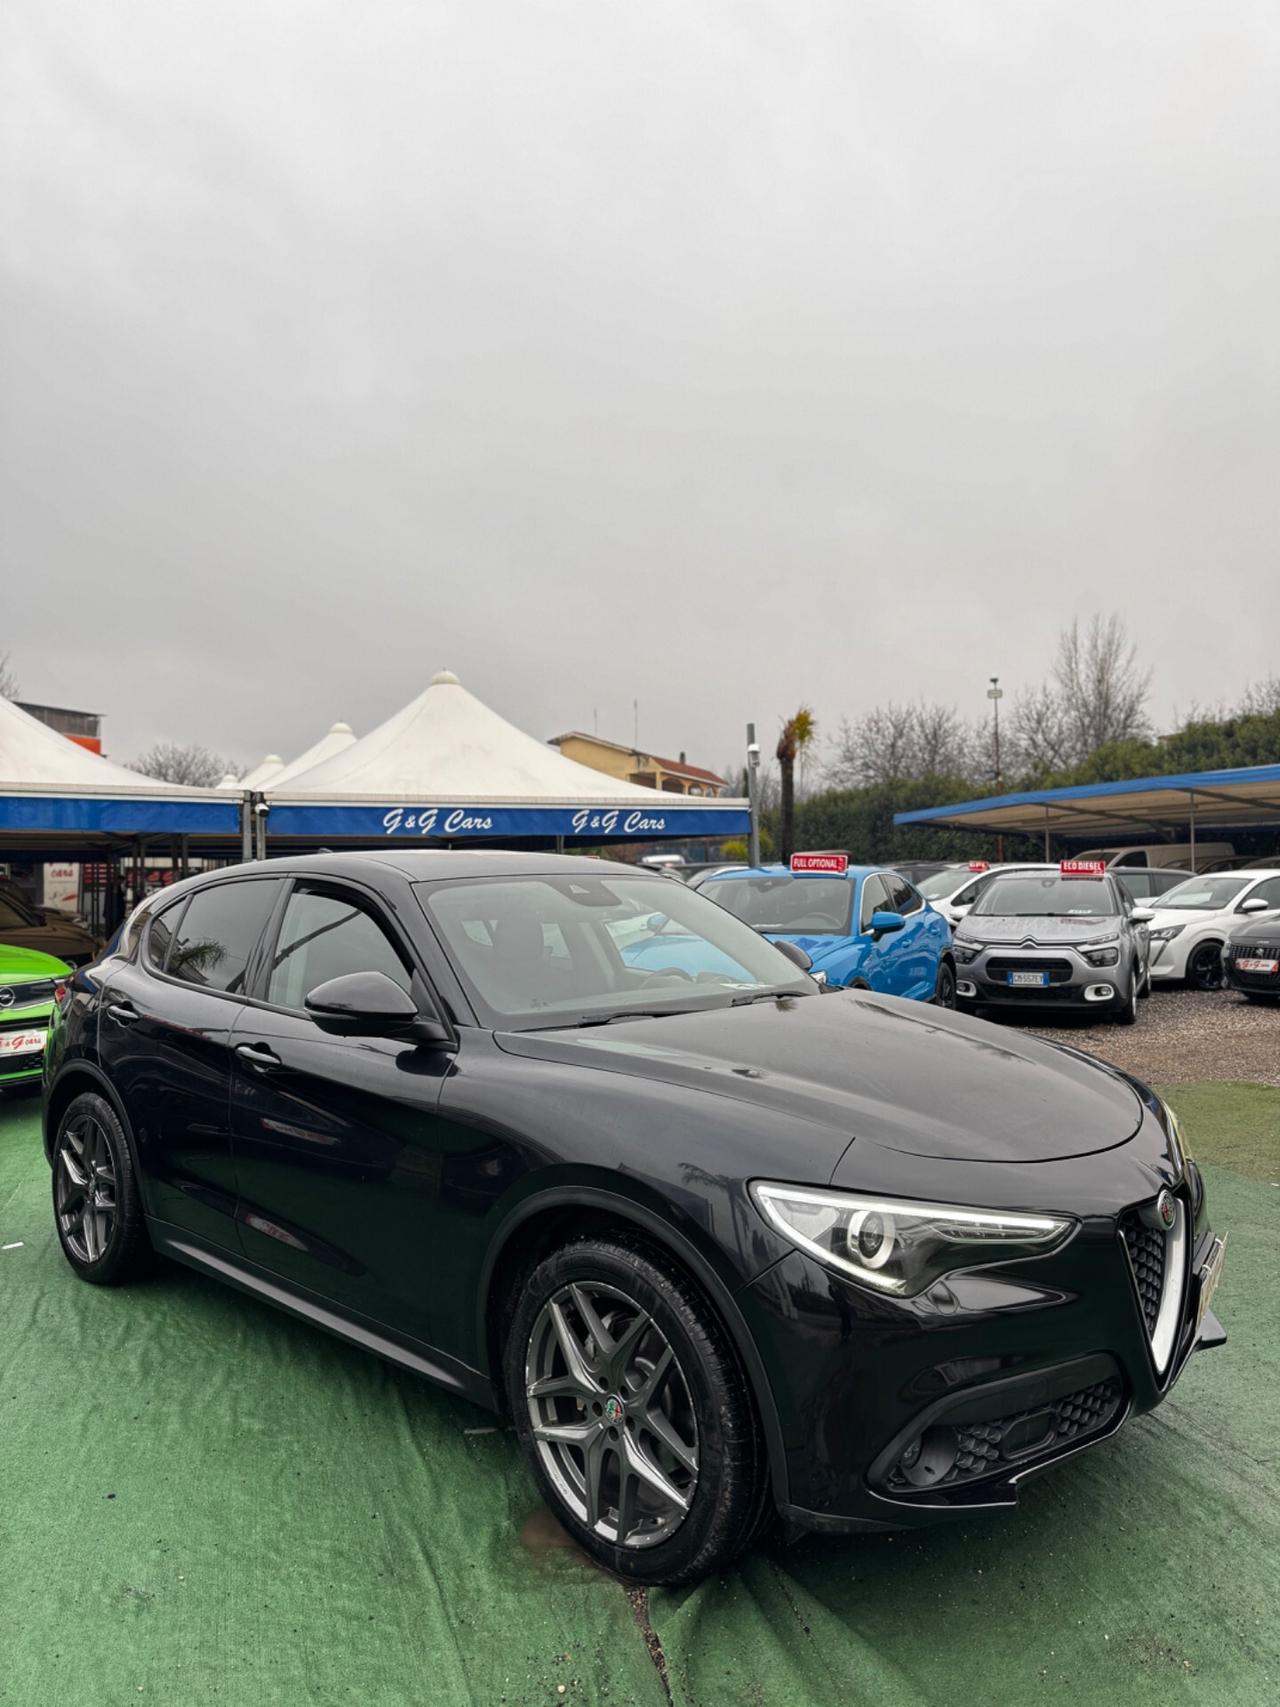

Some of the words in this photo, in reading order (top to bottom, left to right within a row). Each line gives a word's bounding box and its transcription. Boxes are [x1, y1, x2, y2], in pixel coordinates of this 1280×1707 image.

[443, 809, 494, 833] Cars
[623, 811, 666, 833] Cars
[793, 858, 807, 868] FULL
[808, 858, 838, 869] OPTIONAL
[1063, 861, 1077, 870] ECO
[1078, 861, 1102, 871] DIESEL
